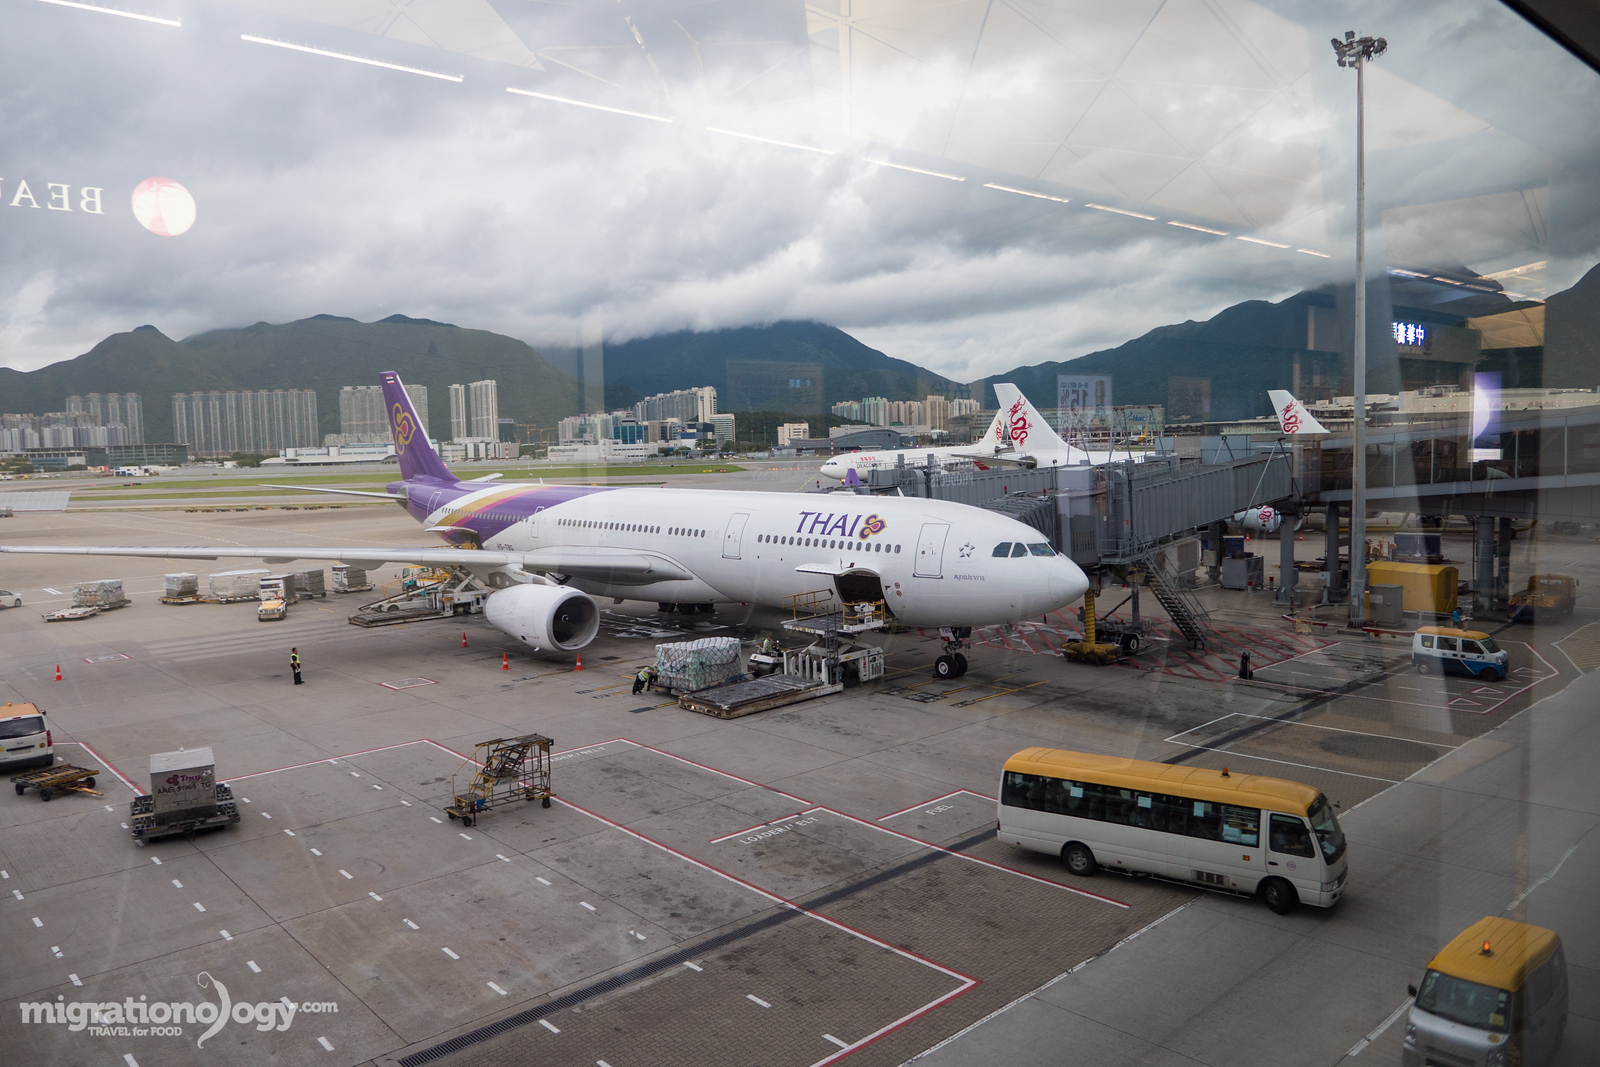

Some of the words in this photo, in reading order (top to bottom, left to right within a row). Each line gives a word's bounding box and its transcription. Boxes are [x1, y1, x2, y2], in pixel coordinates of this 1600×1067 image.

[796, 511, 863, 537] THAI
[157, 786, 173, 794] AKE
[925, 803, 954, 816] FUEL
